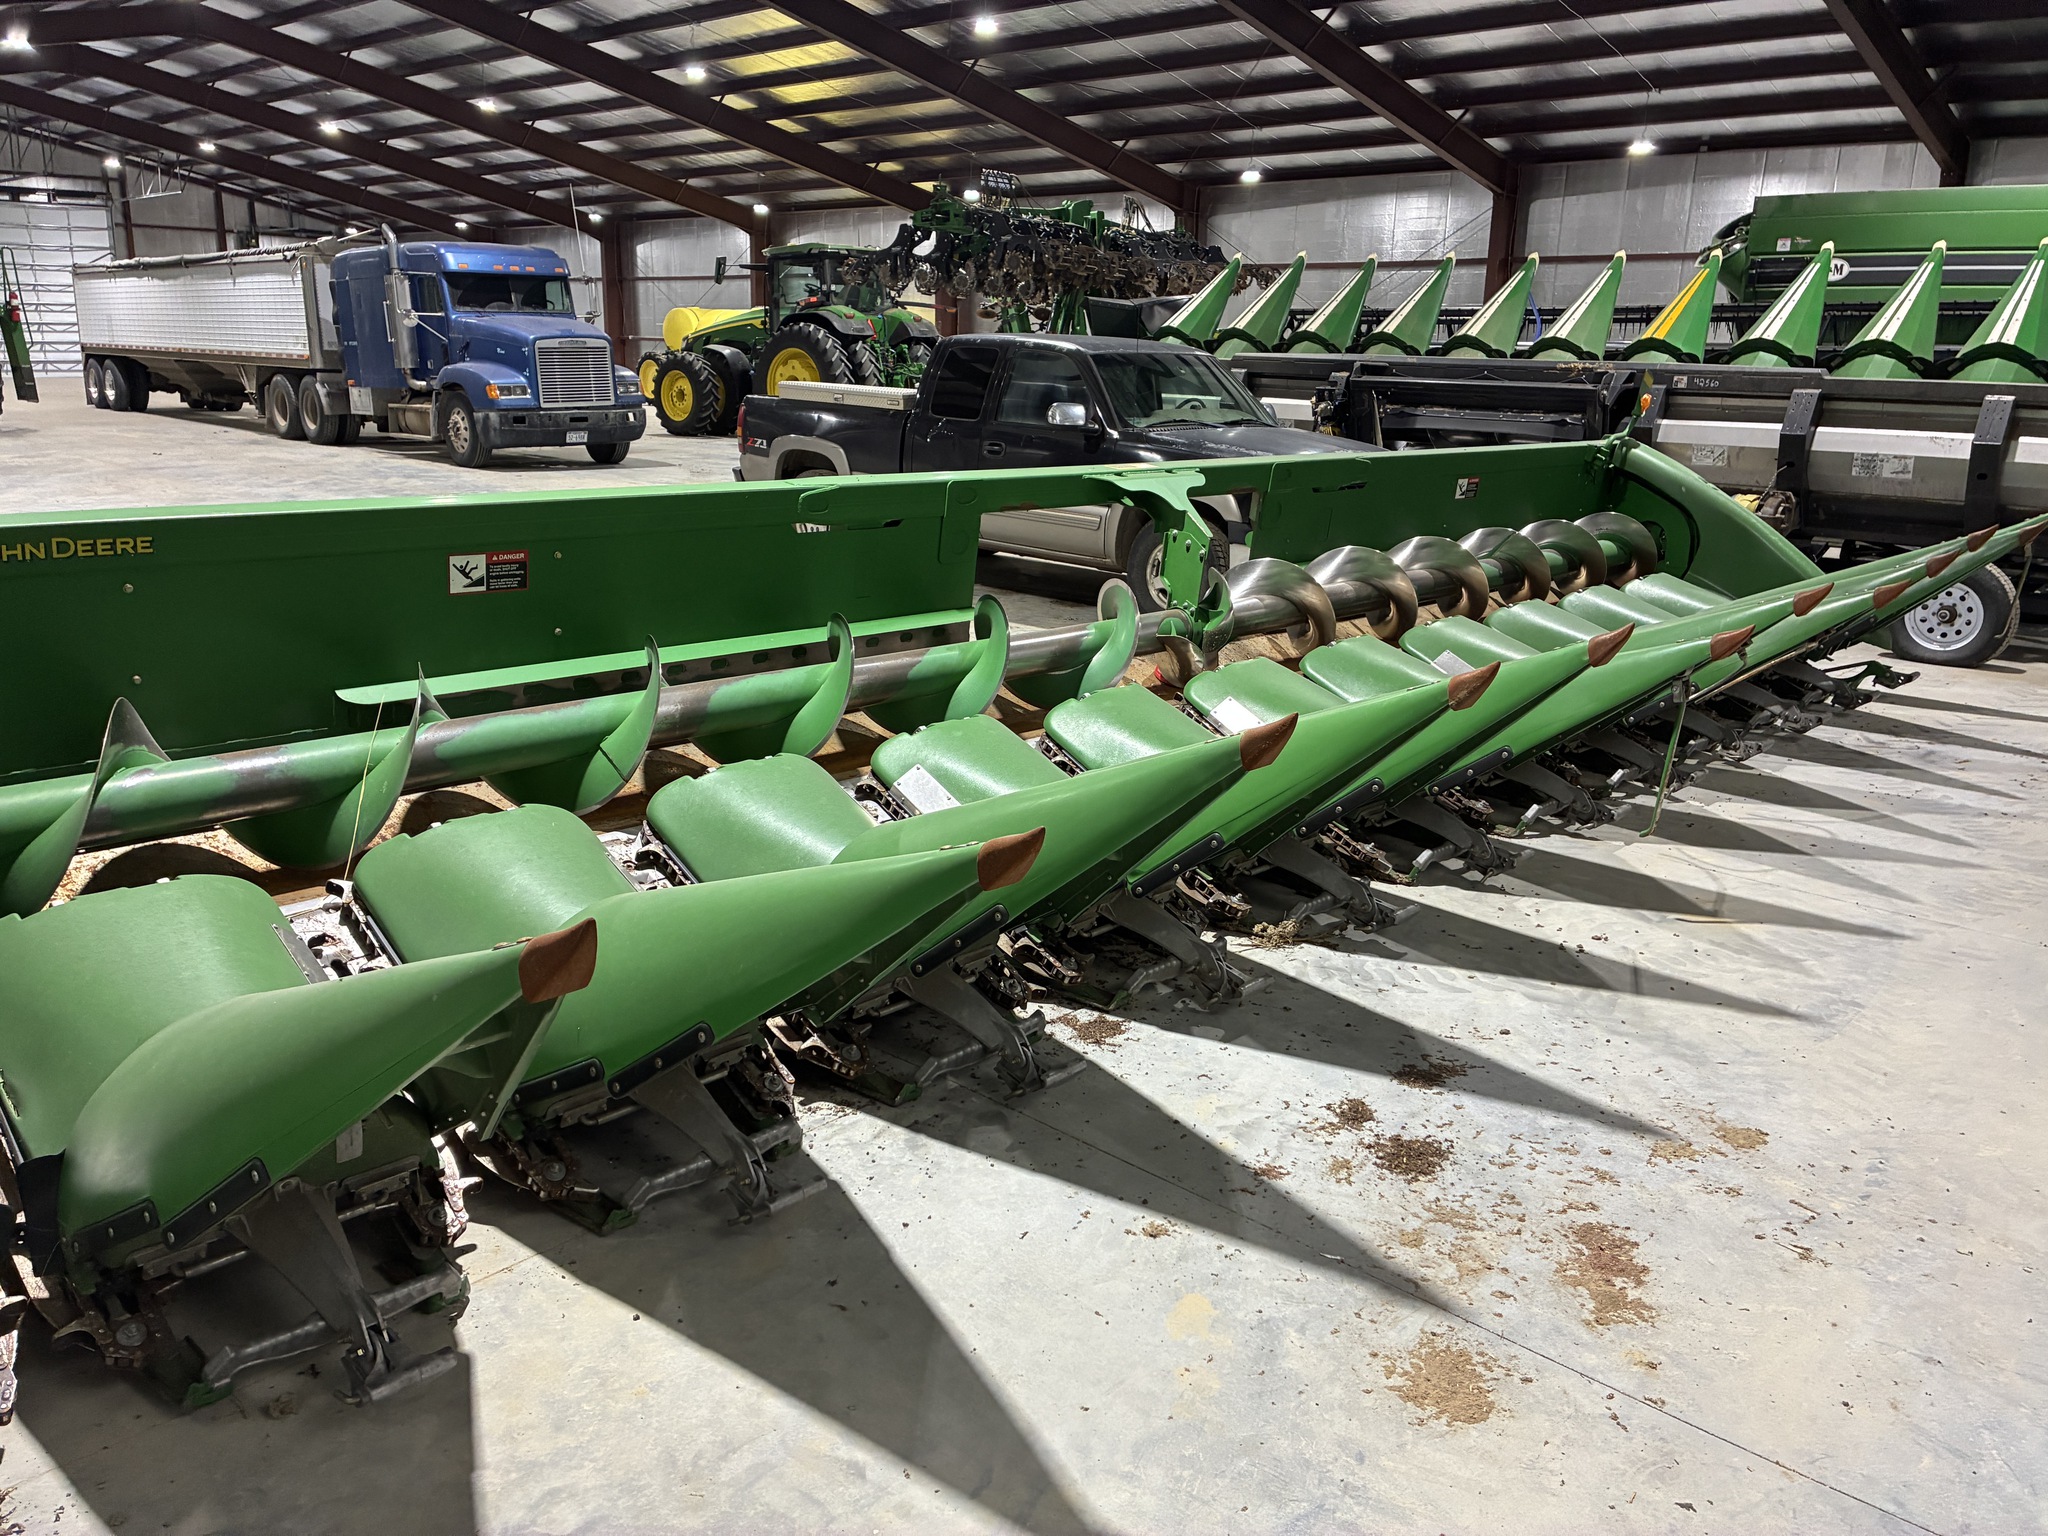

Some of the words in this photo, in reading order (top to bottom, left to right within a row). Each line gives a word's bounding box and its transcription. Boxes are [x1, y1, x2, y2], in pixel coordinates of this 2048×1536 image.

[1830, 263, 1845, 276] M
[746, 437, 767, 449] Z71
[51, 536, 154, 559] DEERE
